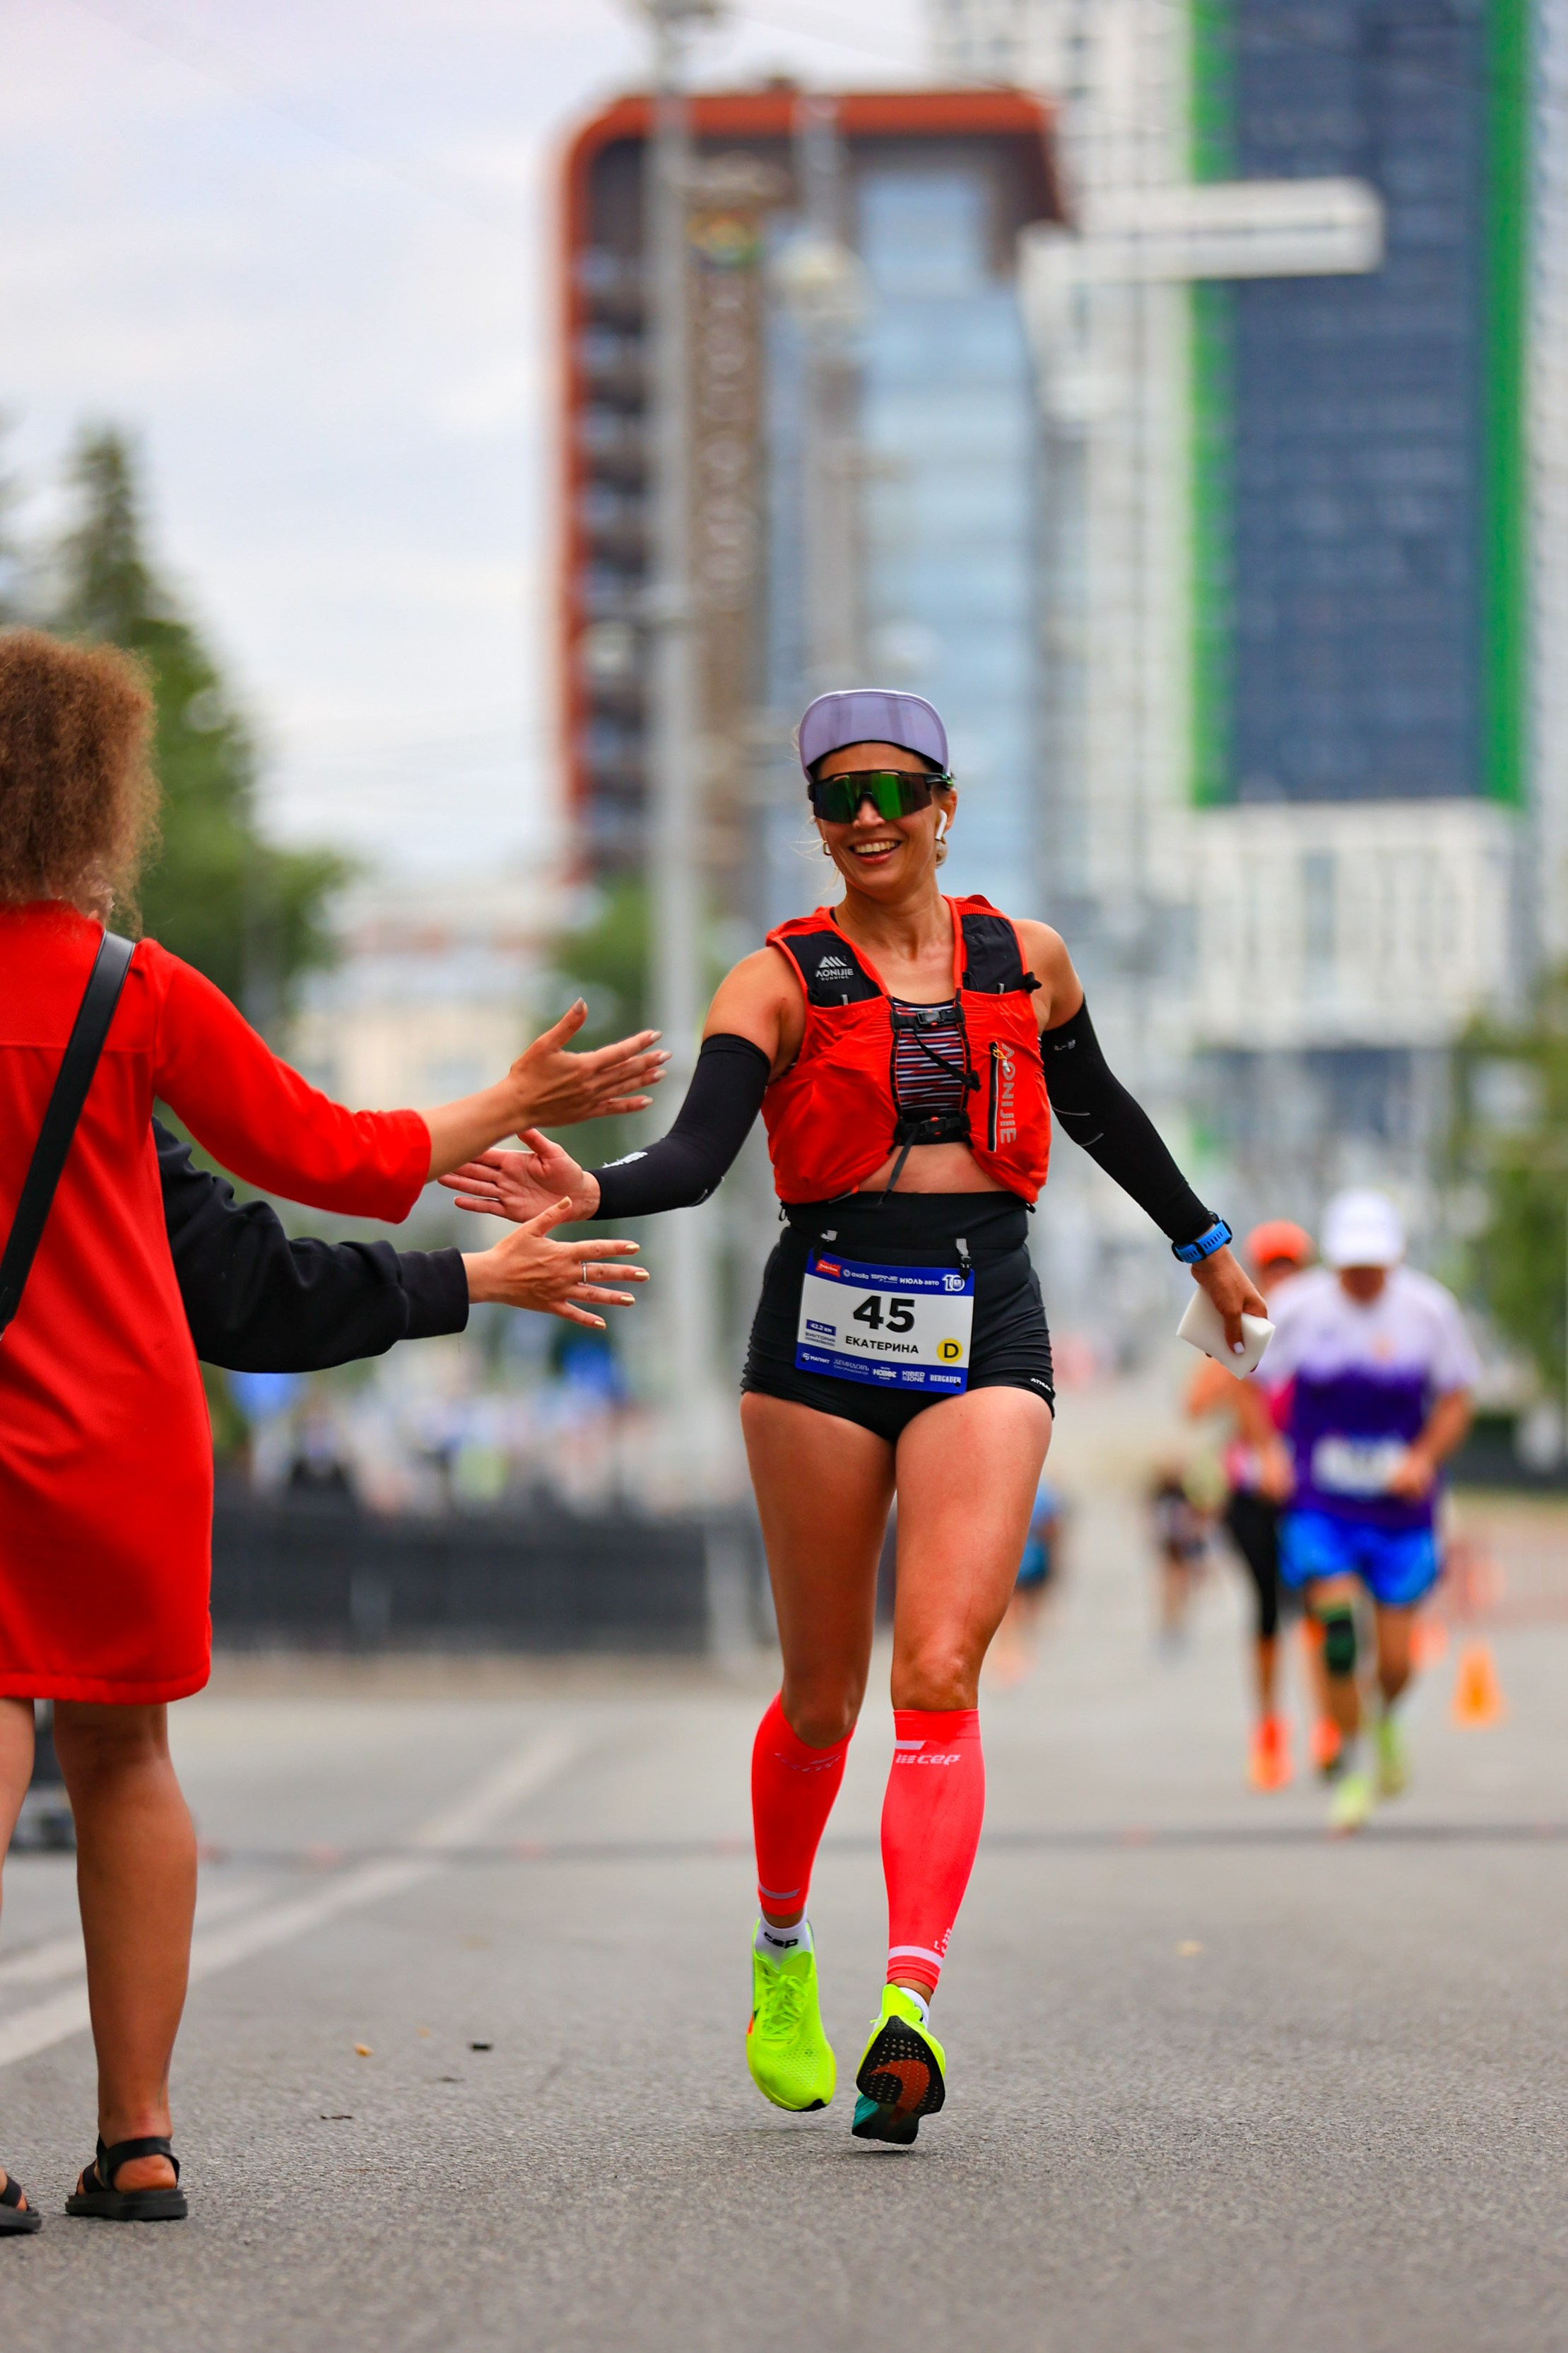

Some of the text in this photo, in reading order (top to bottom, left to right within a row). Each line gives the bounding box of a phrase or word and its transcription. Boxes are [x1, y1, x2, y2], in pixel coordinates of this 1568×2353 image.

[815, 968, 854, 978] AONIJIE
[853, 1295, 916, 1333] 45
[845, 1335, 919, 1354] ЕКАТЕРИНА
[943, 1343, 959, 1359] D
[810, 1356, 830, 1364] МАГНИТ
[764, 1932, 798, 1949] cep
